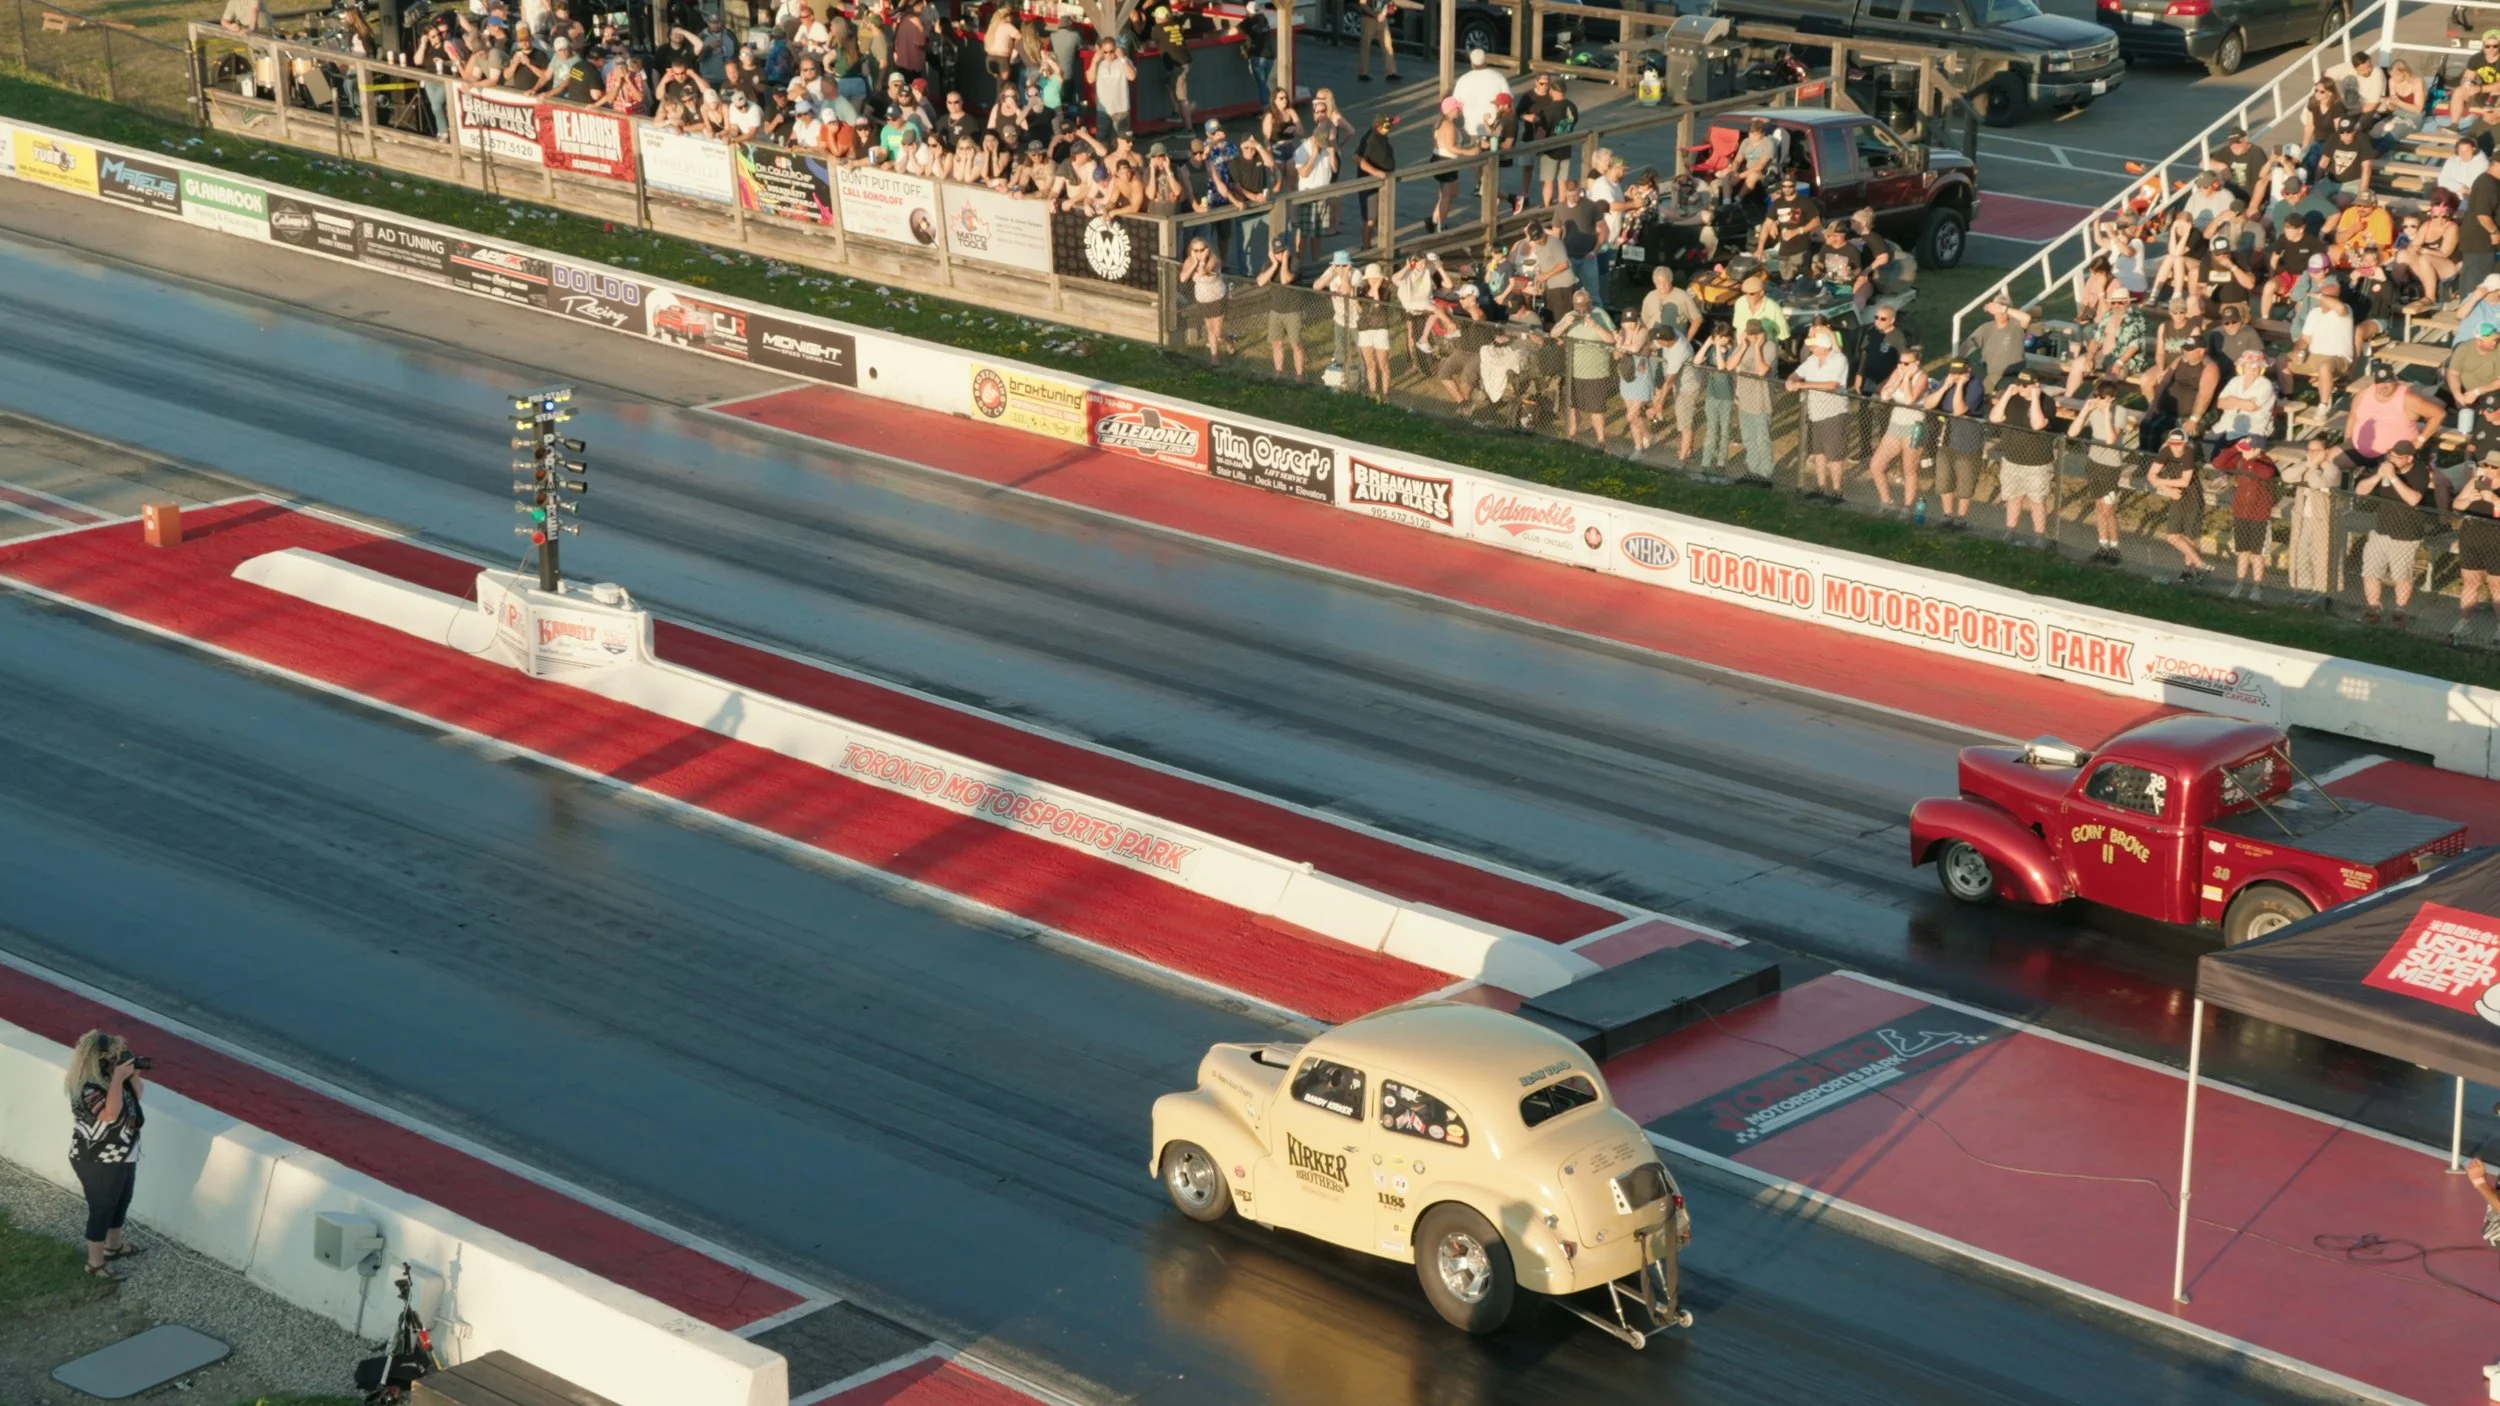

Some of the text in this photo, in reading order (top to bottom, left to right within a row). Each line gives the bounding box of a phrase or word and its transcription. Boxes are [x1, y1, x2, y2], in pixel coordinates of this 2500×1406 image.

[499, 117, 536, 139] GLASS
[101, 157, 177, 194] MATEUS
[841, 171, 869, 188] DON'T
[872, 176, 891, 191] PUT
[892, 179, 901, 192] IT
[127, 184, 174, 200] RACING
[185, 178, 263, 213] GLANBROOK
[843, 187, 862, 198] CALL
[377, 227, 445, 255] AD TUNING
[956, 231, 987, 244] MATCO
[958, 238, 988, 251] TOOLS
[552, 264, 640, 306] DOLDO
[560, 295, 628, 327] Racing
[762, 332, 842, 361] MIDNIGHT
[528, 388, 572, 403] PRE-STAGE
[1009, 377, 1082, 410] broxtuning
[535, 410, 566, 422] STAGE
[1097, 421, 1198, 447] CALEDONIA
[1212, 424, 1252, 469] Tim
[1216, 465, 1327, 501] Stair Lifts Deck Lifts Elevators
[1264, 468, 1309, 485] LIFT SERVICE
[1353, 463, 1449, 503] BREAKAWAY
[1354, 484, 1449, 520] AUTO GLASS
[1475, 493, 1576, 531] Oldsmobile
[1543, 538, 1573, 551] ONTARIO
[1628, 538, 1672, 566] NHRA
[1689, 547, 2128, 680] TORONTO MOTORSPORTS PARK
[2155, 655, 2239, 685] TORONTO
[2156, 670, 2235, 692] MOTORSPORTS PARK
[2224, 692, 2258, 704] CAYUGA
[844, 744, 1193, 872] TORONTO MOTORSPORTS PARK
[2071, 824, 2150, 863] GOIN' BROKE
[2416, 930, 2499, 966] USDM
[2387, 963, 2474, 996] MEET
[2400, 947, 2496, 986] SUPER
[1303, 1093, 1354, 1116] RANDY KIRKER
[1745, 1053, 1908, 1126] MOTORSPORTS PARK
[1287, 1131, 1350, 1188] KIRKER
[1296, 1170, 1344, 1193] BROTHERS
